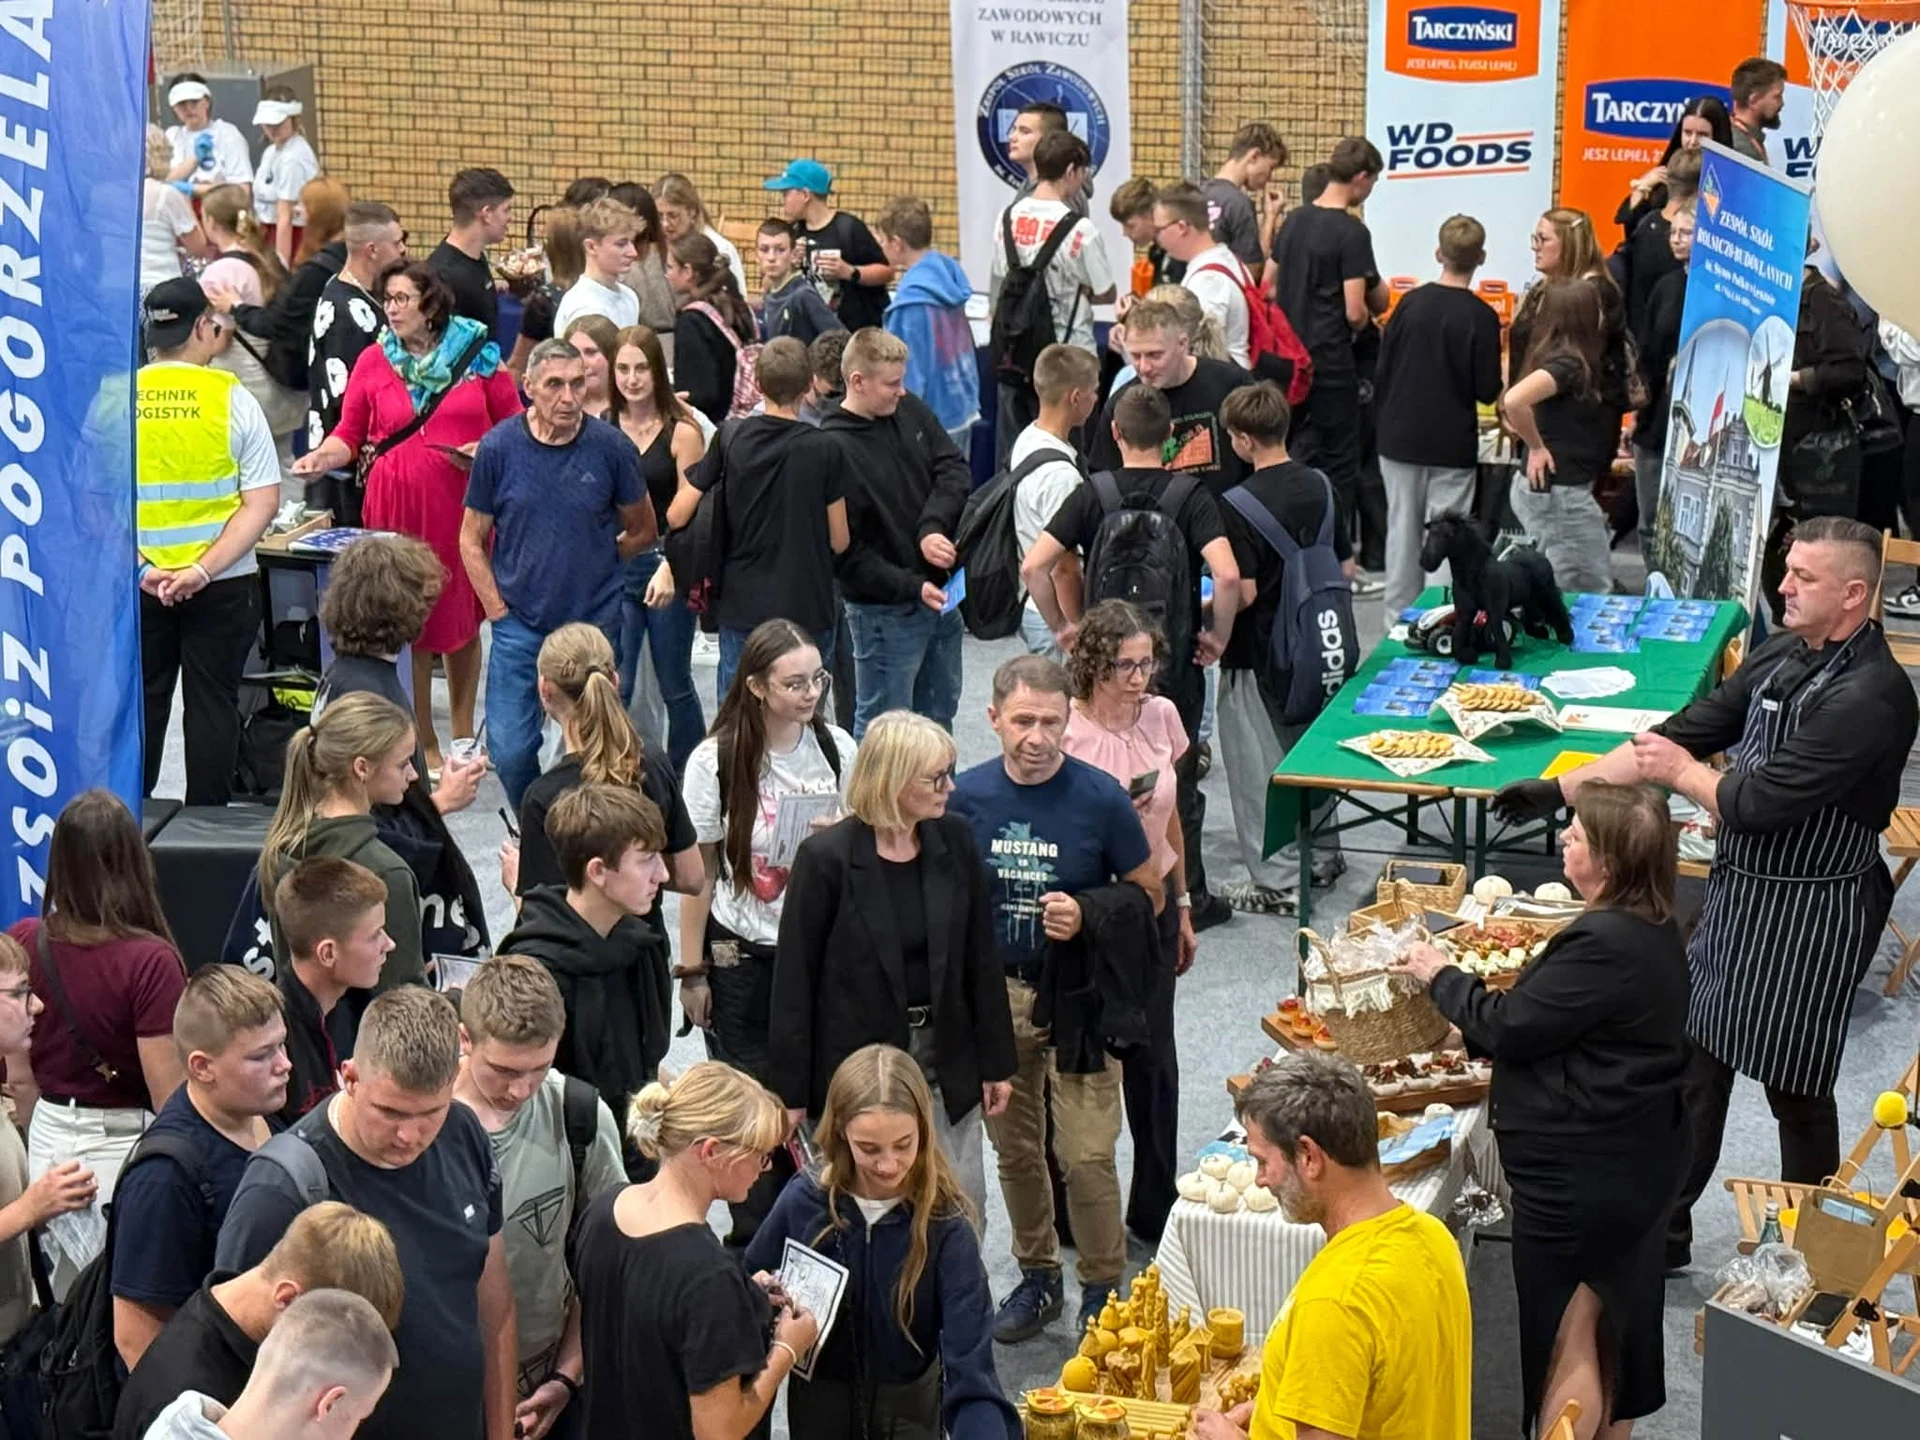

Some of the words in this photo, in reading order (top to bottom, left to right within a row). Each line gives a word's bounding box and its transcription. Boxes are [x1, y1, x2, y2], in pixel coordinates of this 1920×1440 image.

[978, 7, 1102, 25] ZAWODOWYCH
[991, 29, 1005, 43] W
[1011, 30, 1089, 47] RAWICZU
[1412, 16, 1513, 42] TARCZYŃSKI
[1386, 122, 1453, 147] WD
[1388, 141, 1533, 171] FOODS
[1582, 147, 1609, 161] JESZ
[0, 0, 53, 596] POGORZELA
[135, 389, 198, 402] ECHNIK
[135, 406, 202, 419] OGISTYK
[991, 839, 1058, 858] MUSTANG
[997, 868, 1048, 882] VACANCES
